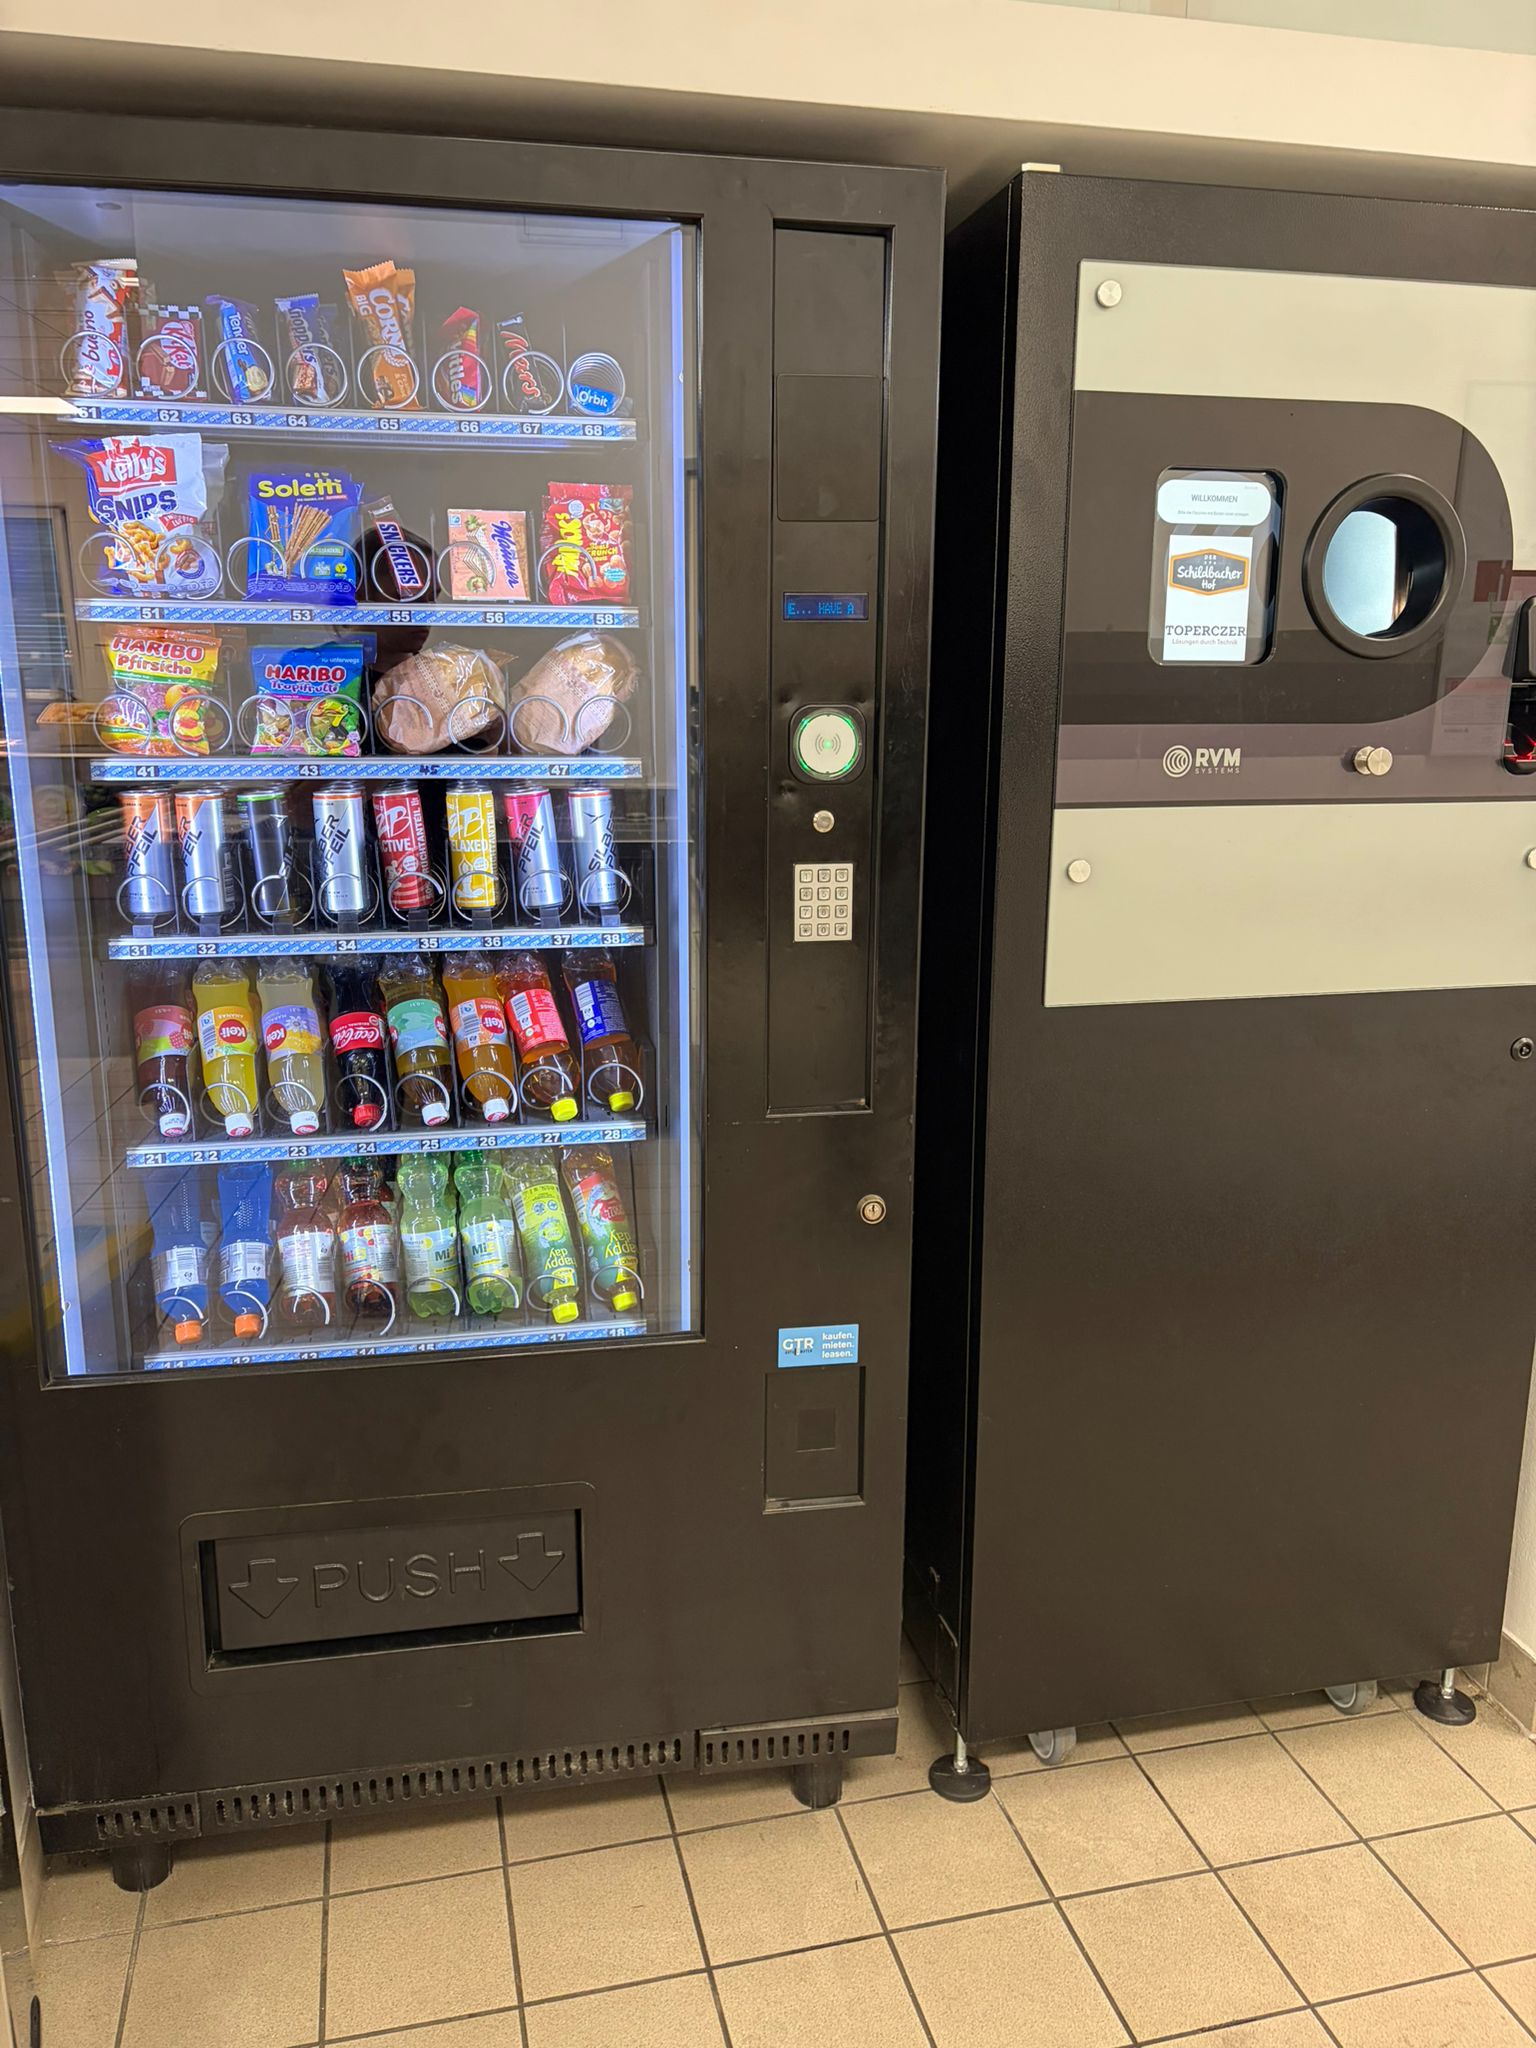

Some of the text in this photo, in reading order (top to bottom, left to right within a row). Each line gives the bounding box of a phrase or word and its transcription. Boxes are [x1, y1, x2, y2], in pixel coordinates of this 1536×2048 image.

[354, 294, 372, 317] BIG
[577, 390, 609, 410] Orbit
[78, 406, 99, 419] 61
[159, 410, 180, 423] 62
[232, 412, 252, 425] 63
[287, 414, 308, 427] 64
[379, 418, 399, 431] 65
[460, 421, 480, 434] 66
[522, 423, 541, 435] 67
[583, 425, 603, 437] 68
[96, 451, 166, 483] Kelly's
[257, 478, 343, 499] Soletti
[1191, 493, 1239, 503] WILLKOMMEN
[96, 489, 178, 524] SNIPS
[491, 520, 520, 589] Manner
[1177, 564, 1243, 580] Schildbacher
[1201, 579, 1217, 590] Hof
[141, 607, 160, 619] 51
[818, 601, 843, 615] HAVE
[847, 601, 855, 615] A
[292, 611, 311, 622] 53
[391, 611, 411, 623] 55
[486, 613, 504, 624] 56
[596, 614, 614, 625] 58
[1165, 625, 1247, 637] TOPERCZER
[111, 636, 204, 663] HARIBO
[116, 654, 193, 676] Pfirsiche
[265, 664, 347, 684] HARIBO
[1195, 747, 1242, 768] RVM
[137, 766, 155, 777] 41
[300, 765, 319, 777] 43
[550, 765, 569, 776] 47
[1194, 767, 1241, 775] SYSTEMS
[519, 825, 545, 874] PFEIL
[338, 940, 356, 951] 34
[420, 938, 438, 949] 35
[484, 937, 502, 948] 36
[553, 935, 571, 945] 37
[603, 934, 621, 945] 38
[131, 946, 149, 956] 31
[197, 944, 217, 955] 32
[483, 1017, 505, 1030] Keli
[219, 1025, 247, 1039] Keli
[264, 1028, 285, 1046] Keli
[544, 1132, 561, 1143] 27
[604, 1129, 622, 1140] 28
[358, 1142, 376, 1153] 24
[422, 1139, 439, 1150] 25
[479, 1136, 496, 1147] 26
[290, 1146, 308, 1158] 23
[146, 1154, 163, 1164] 21
[609, 1229, 632, 1244] day
[548, 1247, 569, 1258] day
[550, 1332, 566, 1342] 17
[609, 1327, 625, 1337] 18
[822, 1331, 855, 1341] kaufen.
[782, 1336, 815, 1356] GTR
[822, 1341, 855, 1350] mieten.
[821, 1350, 853, 1359] leasen.
[312, 1548, 487, 1609] PUSH
